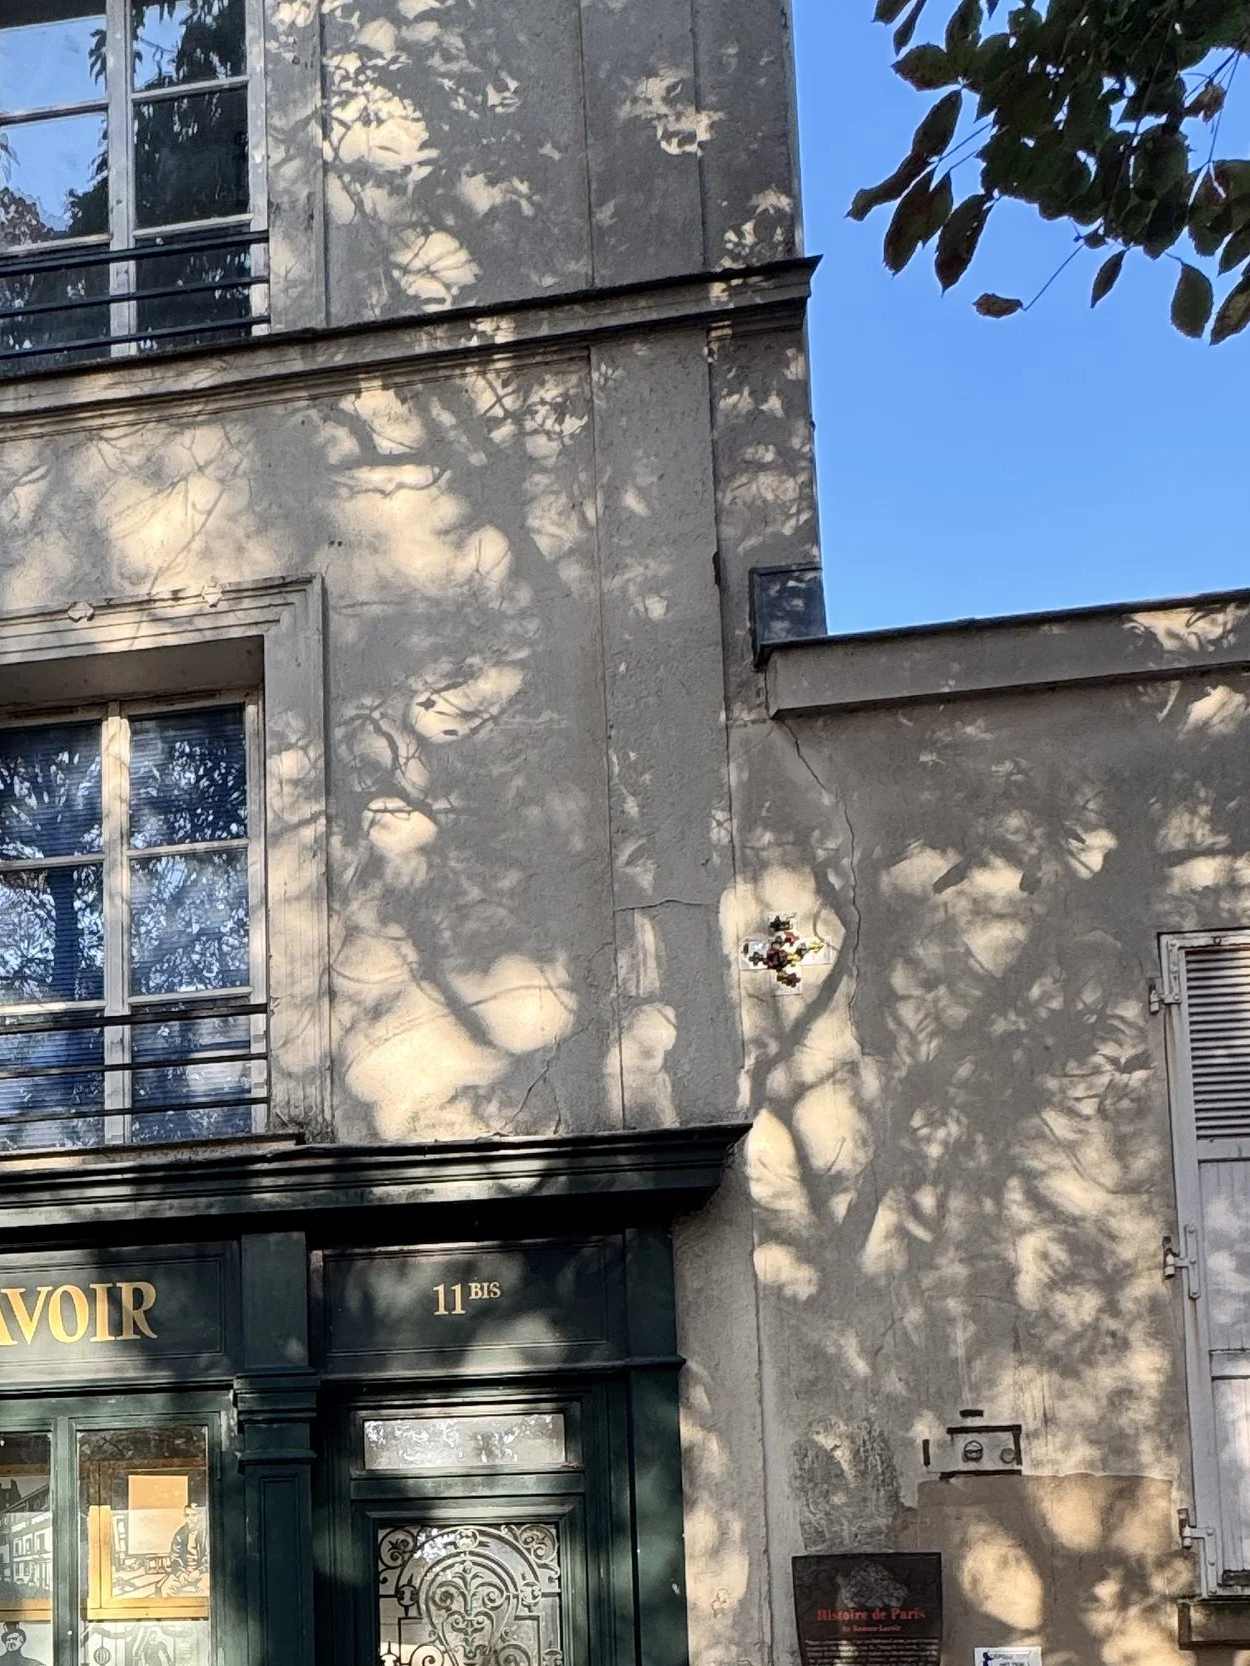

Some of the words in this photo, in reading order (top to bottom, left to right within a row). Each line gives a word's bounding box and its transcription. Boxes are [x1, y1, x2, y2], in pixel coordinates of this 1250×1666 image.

[816, 1608, 868, 1621] Histoire
[871, 1607, 887, 1621] de
[890, 1606, 926, 1621] Paris
